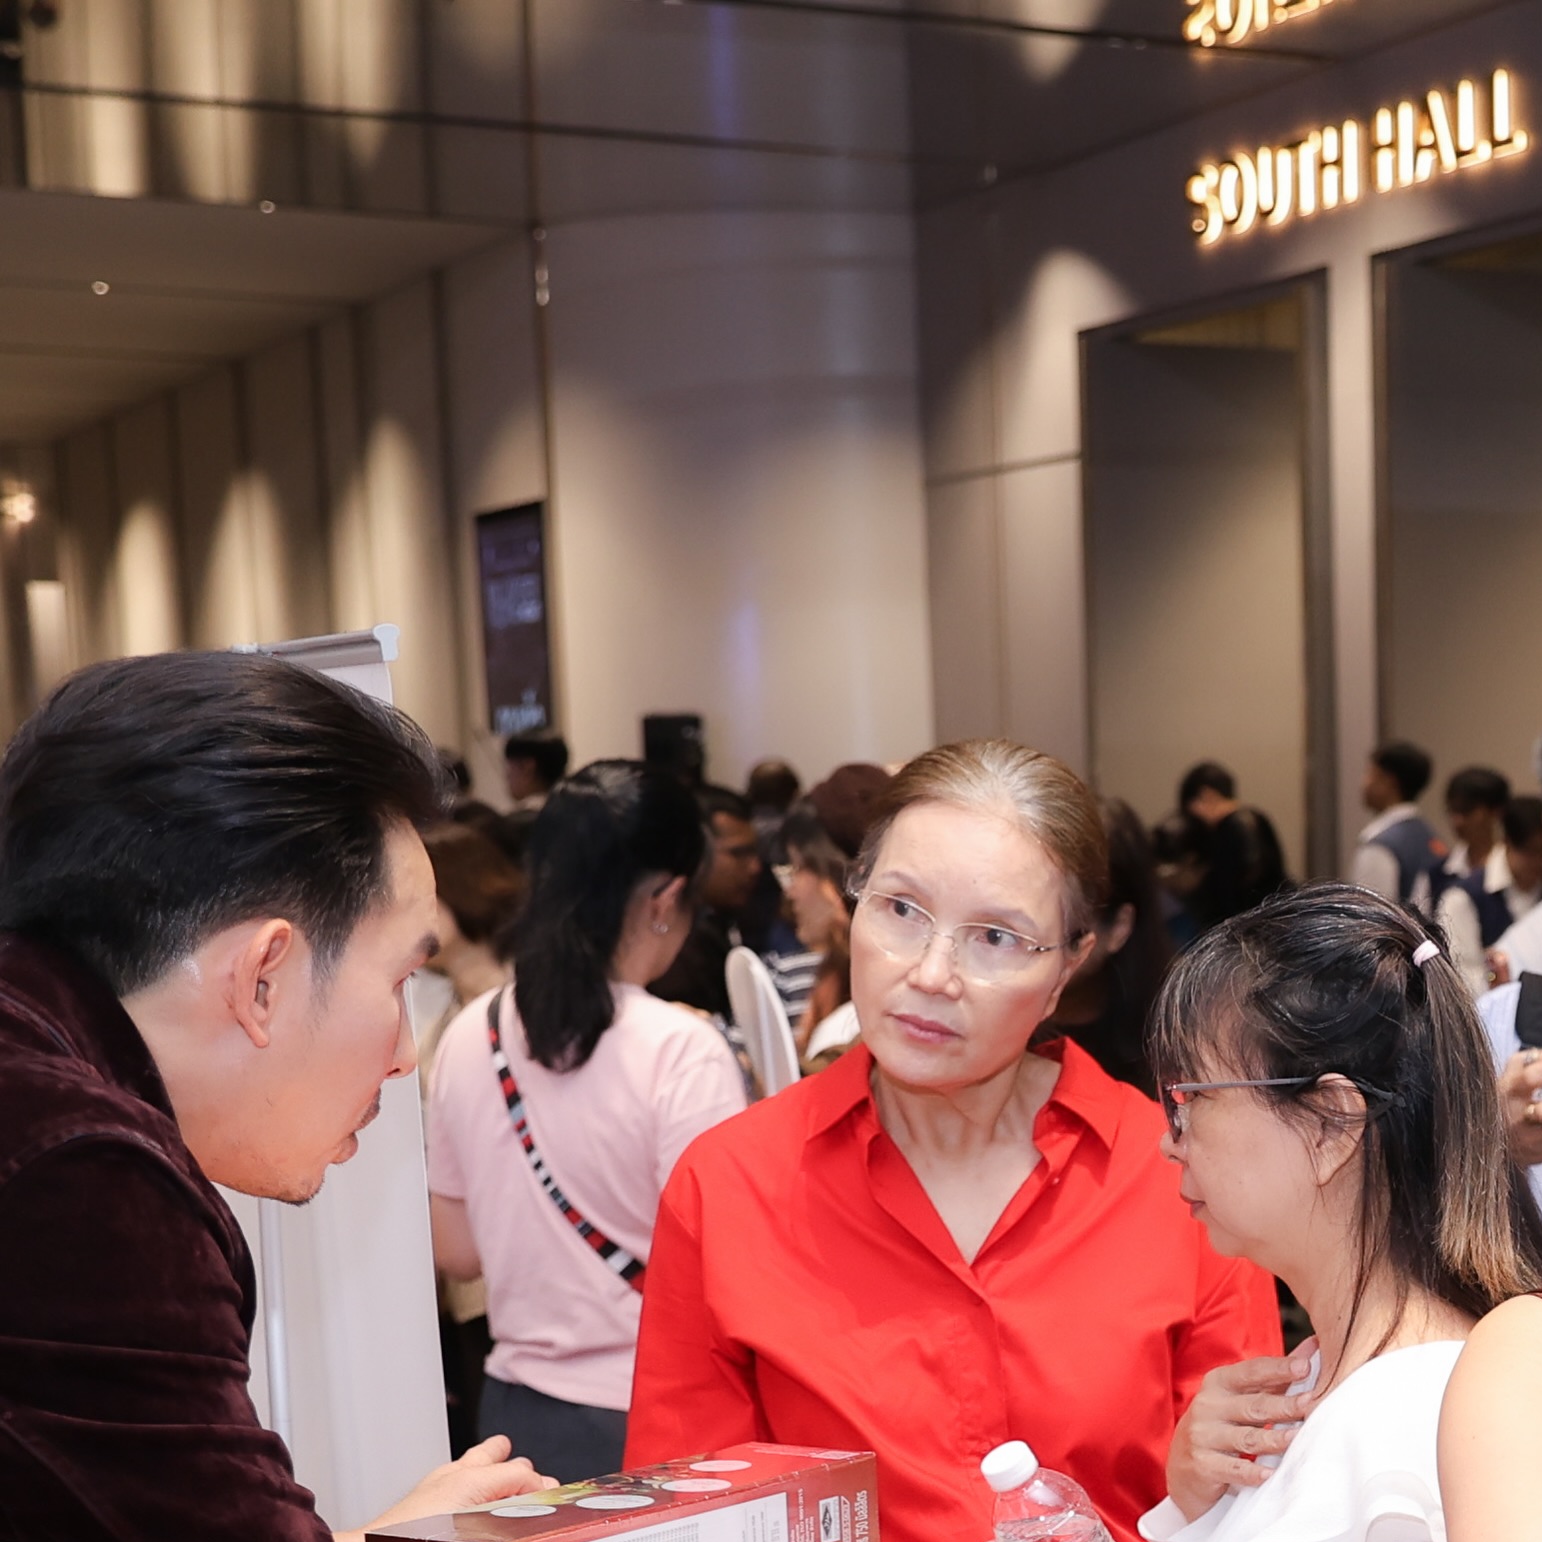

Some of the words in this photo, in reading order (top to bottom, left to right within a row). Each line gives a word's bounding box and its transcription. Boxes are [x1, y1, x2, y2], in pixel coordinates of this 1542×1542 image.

[1187, 118, 1361, 247] SOUTH
[1373, 67, 1531, 195] HALL
[856, 1521, 868, 1536] 750
